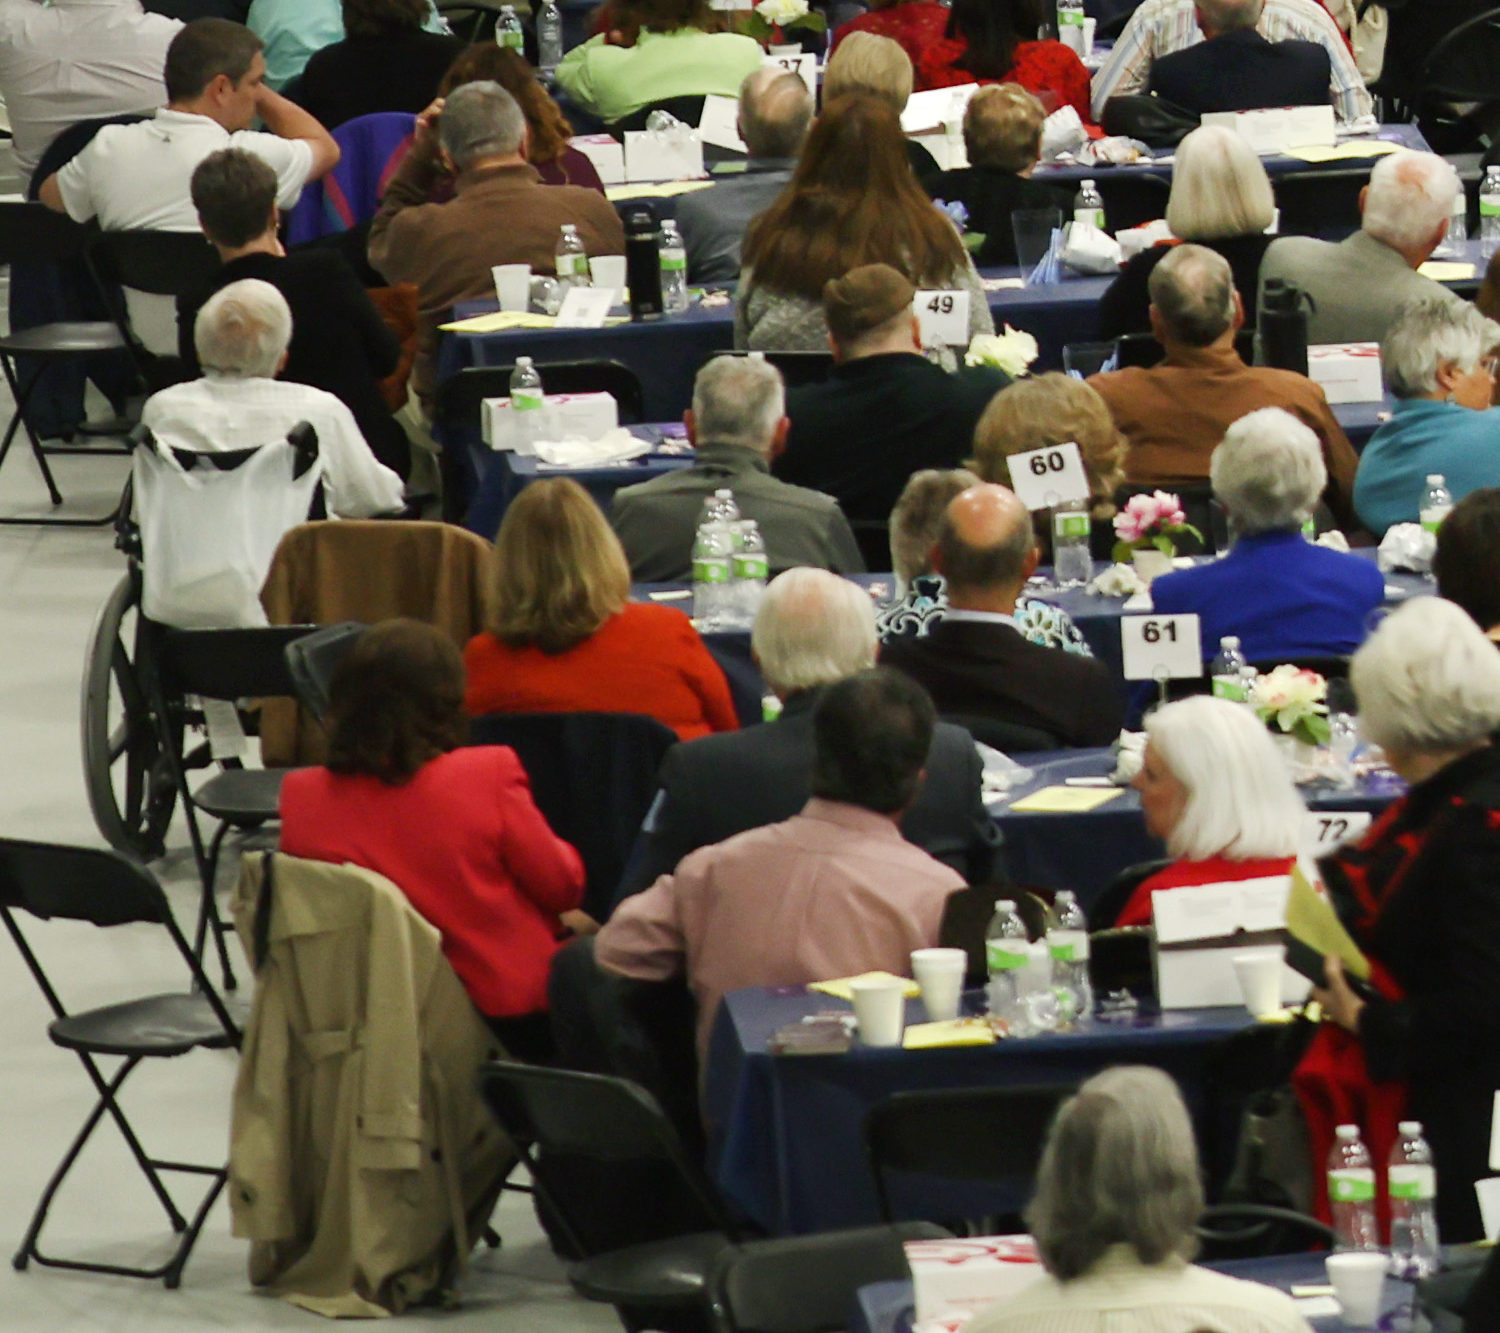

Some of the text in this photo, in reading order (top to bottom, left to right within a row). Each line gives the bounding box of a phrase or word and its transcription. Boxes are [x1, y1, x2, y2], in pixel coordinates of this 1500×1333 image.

[928, 296, 953, 314] 49
[1030, 451, 1064, 476] 60
[1142, 621, 1177, 642] 61
[1318, 818, 1349, 842] 72
